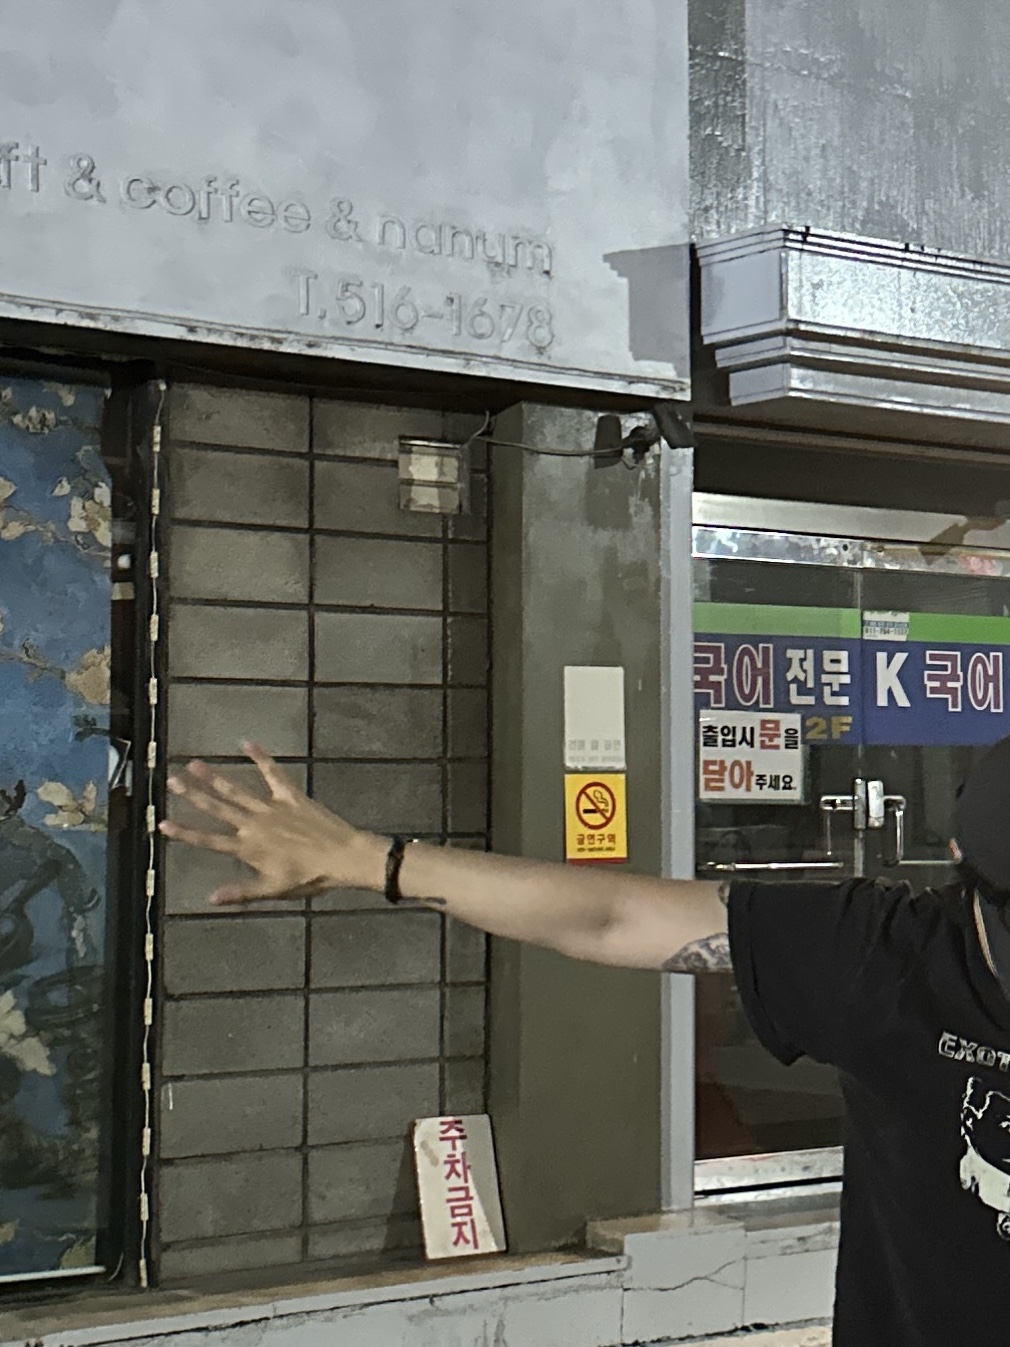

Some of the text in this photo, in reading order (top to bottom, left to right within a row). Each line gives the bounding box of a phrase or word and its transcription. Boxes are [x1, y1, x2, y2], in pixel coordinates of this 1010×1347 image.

[65, 153, 107, 204] &
[119, 174, 312, 234] coffee
[326, 196, 364, 243] &
[375, 214, 553, 277] nanum
[290, 271, 554, 350] T.516-1678
[693, 642, 852, 708] 국어 전문
[876, 651, 911, 708] K
[924, 650, 1003, 713] 국어
[805, 716, 853, 740] 2F
[439, 1119, 480, 1250] 주차금지
